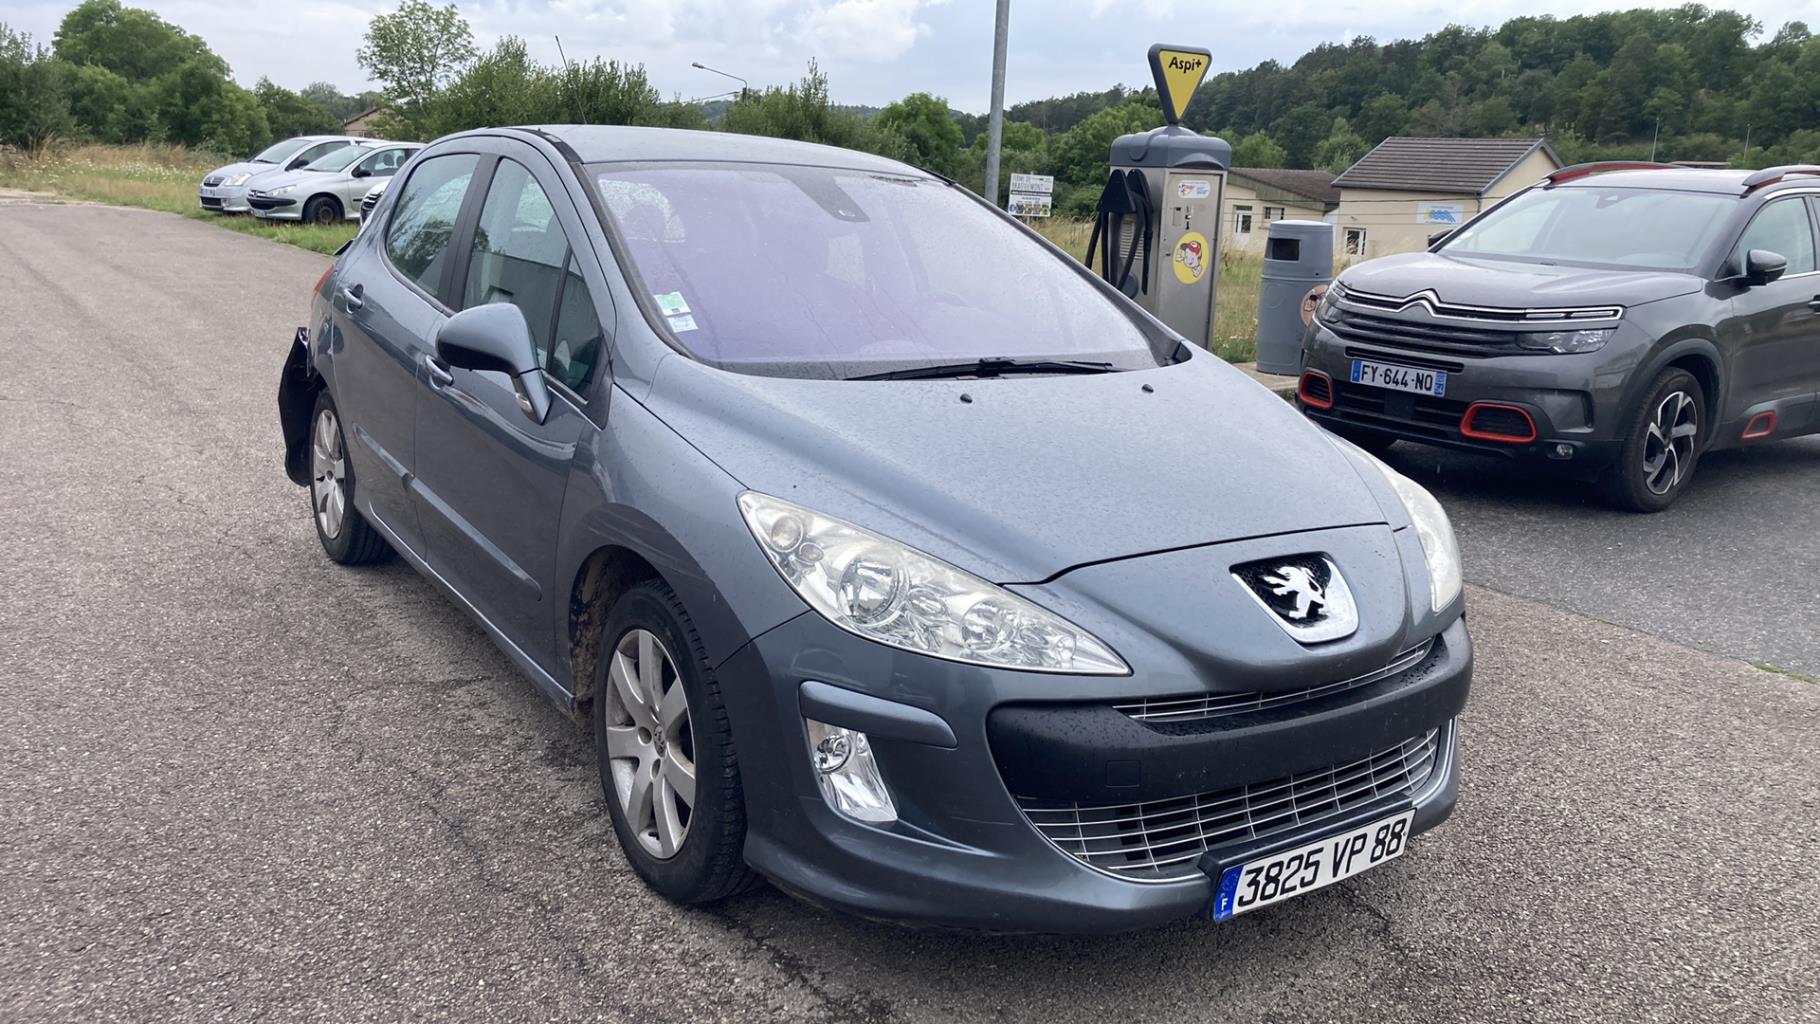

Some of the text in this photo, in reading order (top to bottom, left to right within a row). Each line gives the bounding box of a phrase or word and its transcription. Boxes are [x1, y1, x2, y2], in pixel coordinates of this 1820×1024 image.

[1168, 56, 1202, 74] Aspi+
[1237, 817, 1408, 907] 3825 VP 88
[1220, 897, 1229, 911] F
